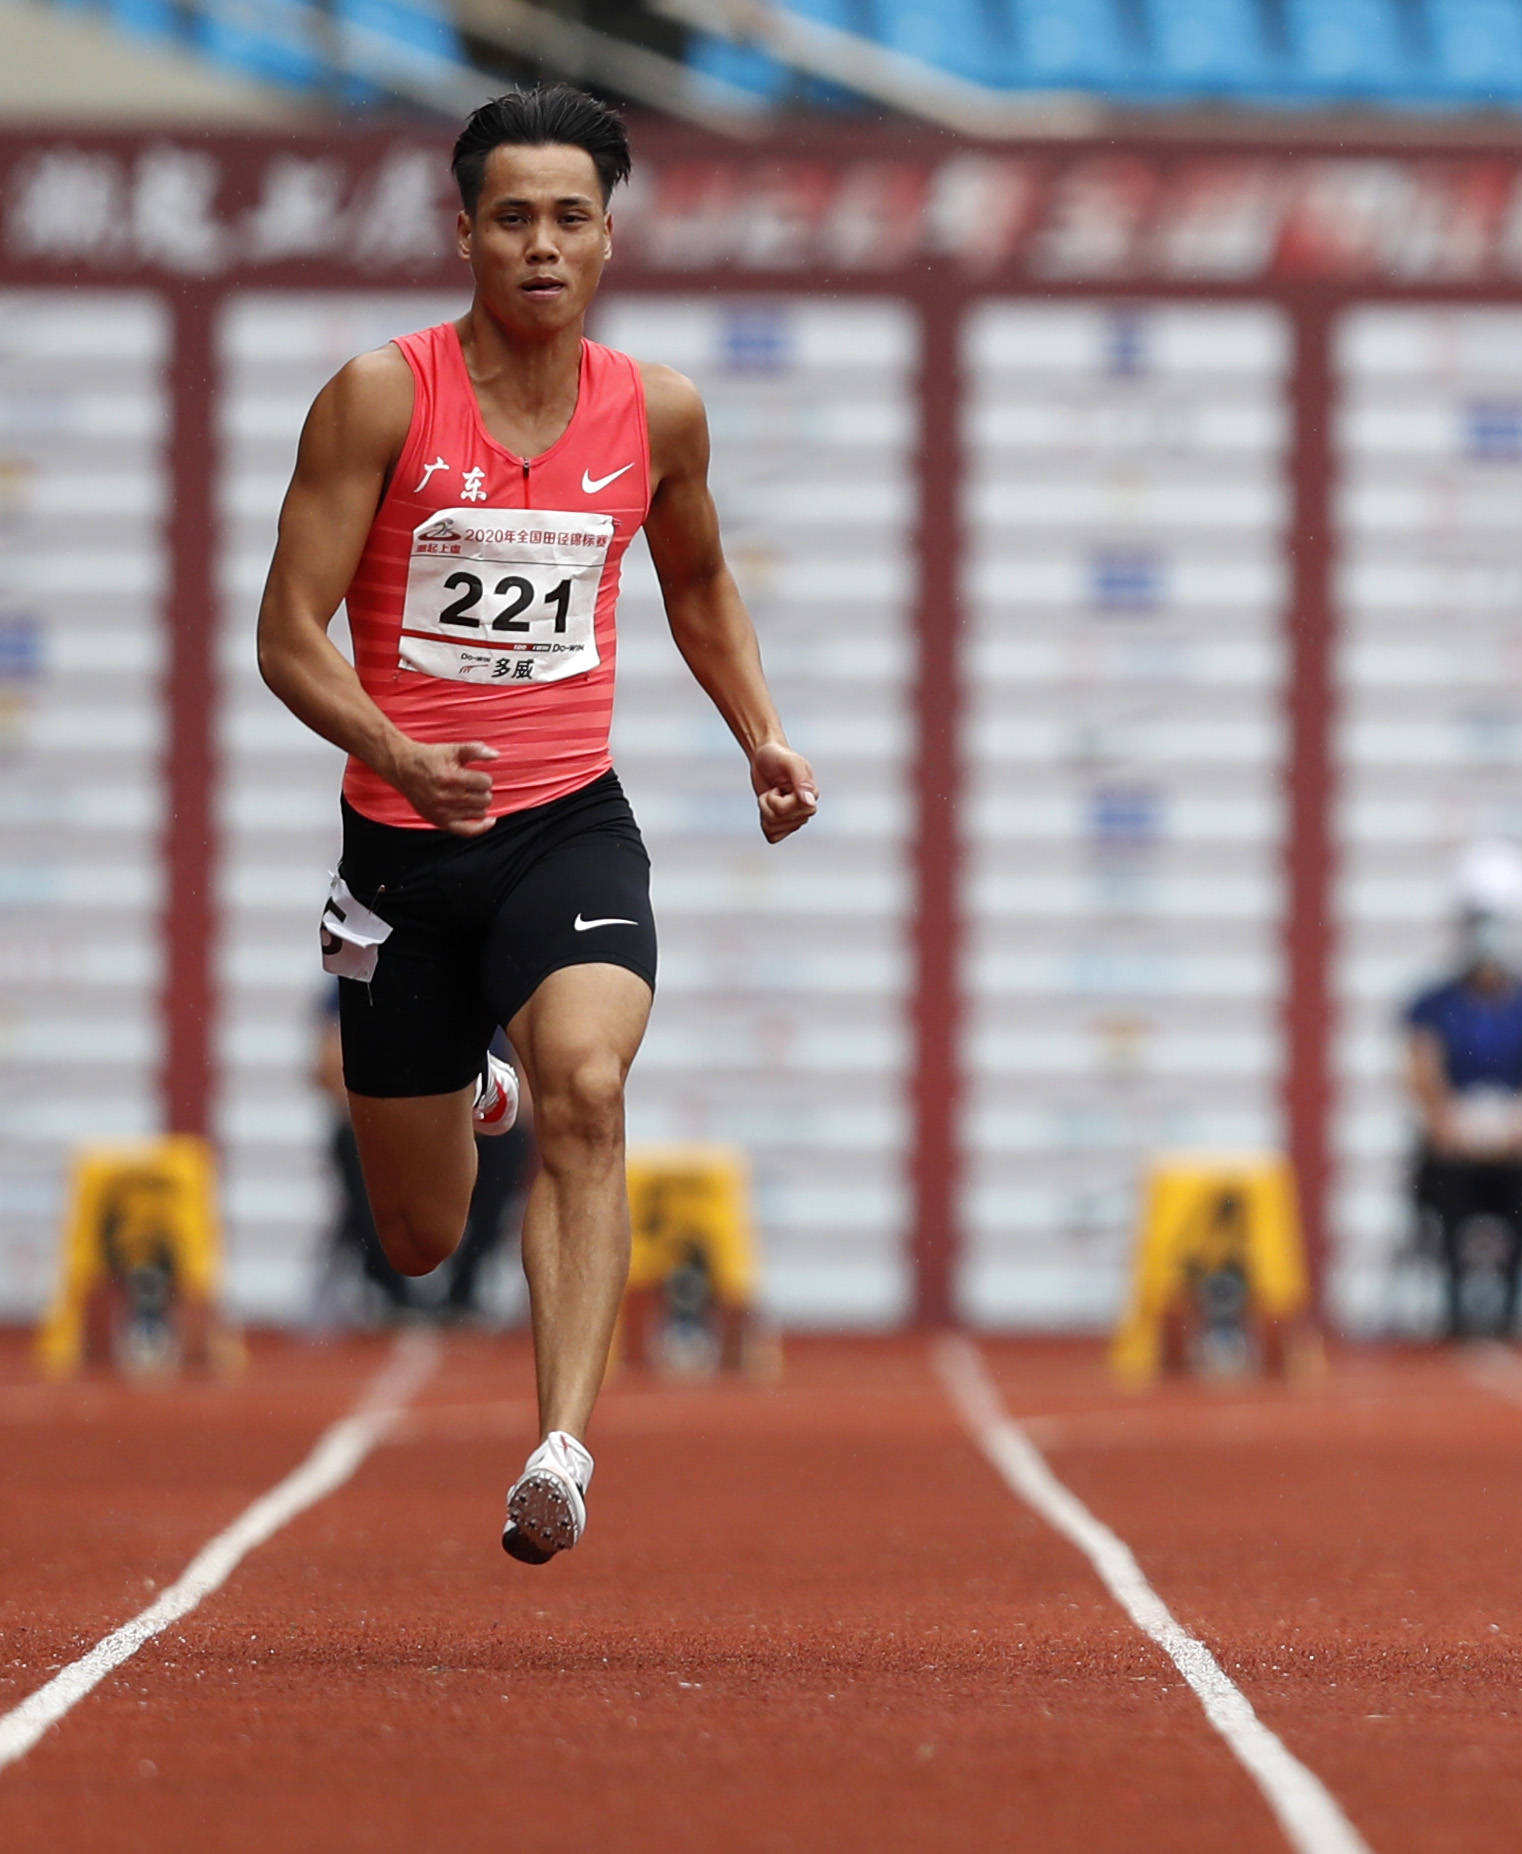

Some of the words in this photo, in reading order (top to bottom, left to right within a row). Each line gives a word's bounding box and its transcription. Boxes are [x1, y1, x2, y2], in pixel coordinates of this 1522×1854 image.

[413, 456, 488, 502] 广东
[439, 571, 572, 633] 221
[491, 658, 534, 679] 多威
